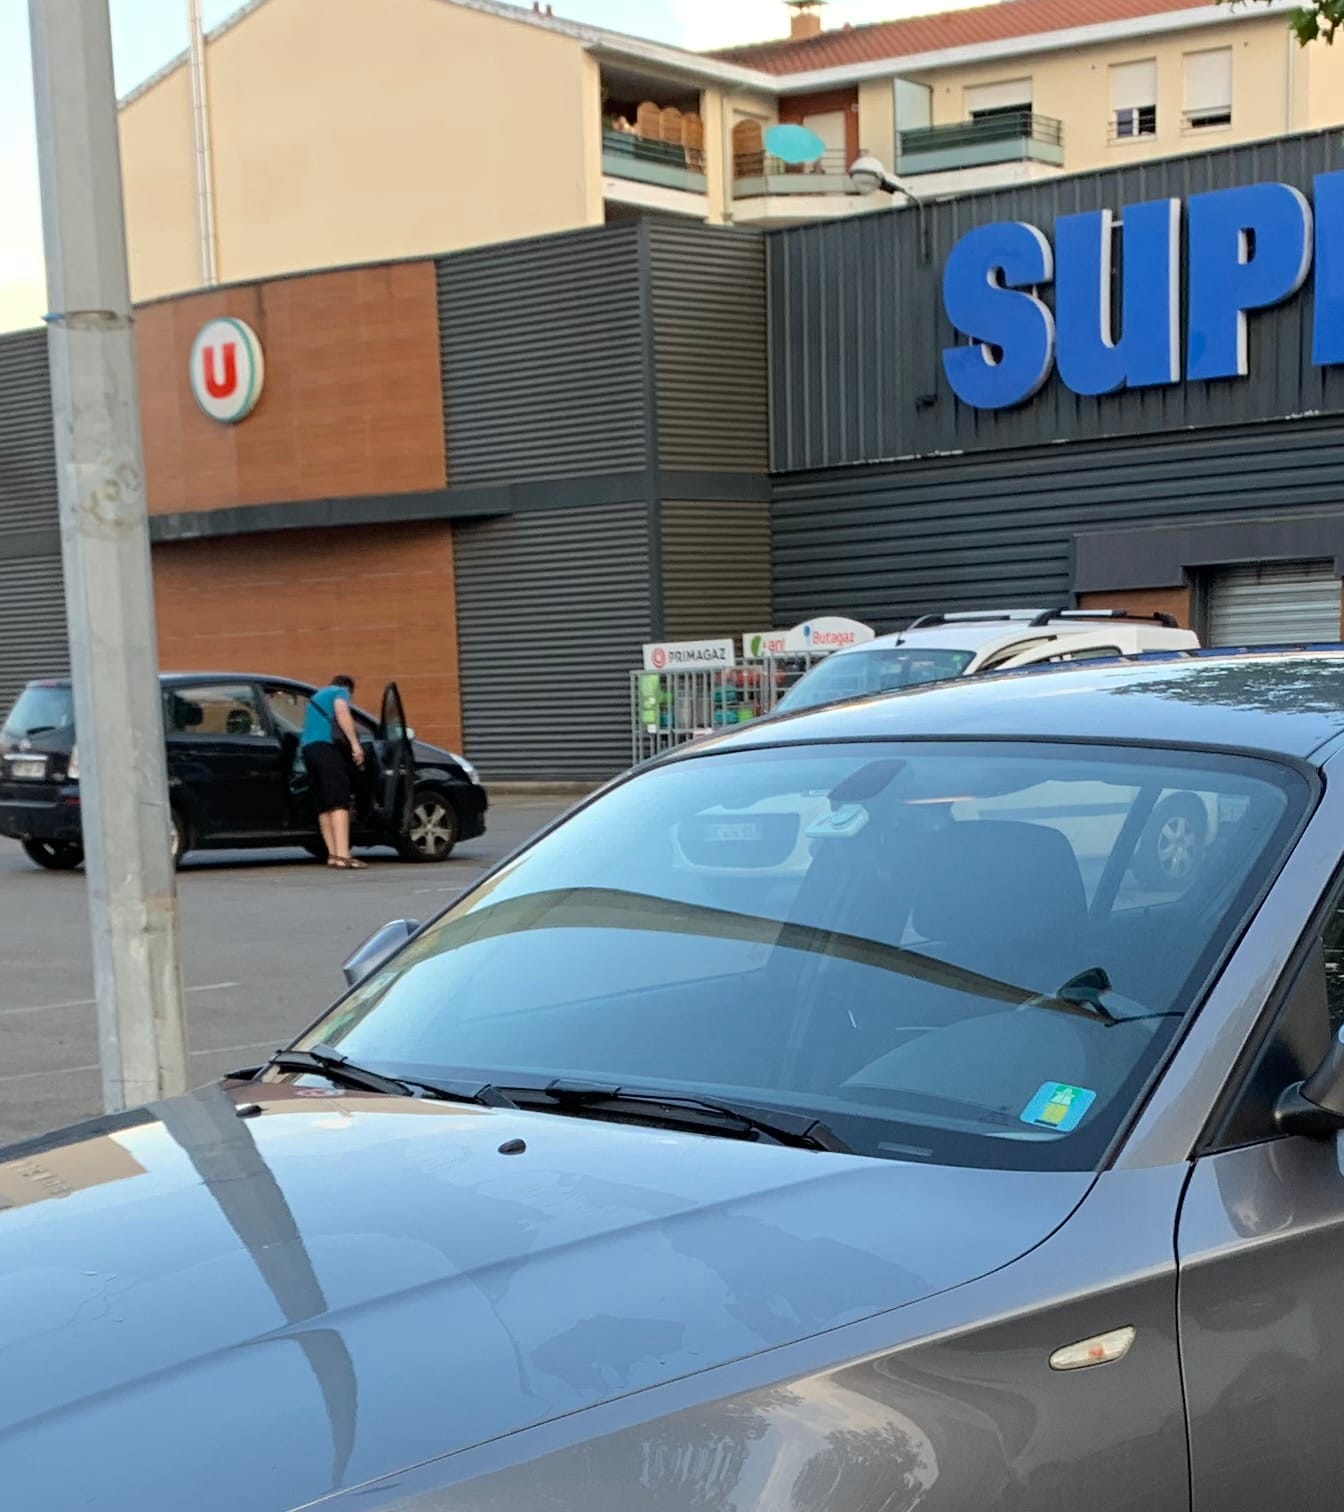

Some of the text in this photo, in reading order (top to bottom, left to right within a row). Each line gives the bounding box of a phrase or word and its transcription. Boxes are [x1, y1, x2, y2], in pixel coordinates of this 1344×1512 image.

[202, 341, 237, 399] U
[812, 631, 856, 648] Butagaz
[668, 647, 727, 664] PRIMAGAZ
